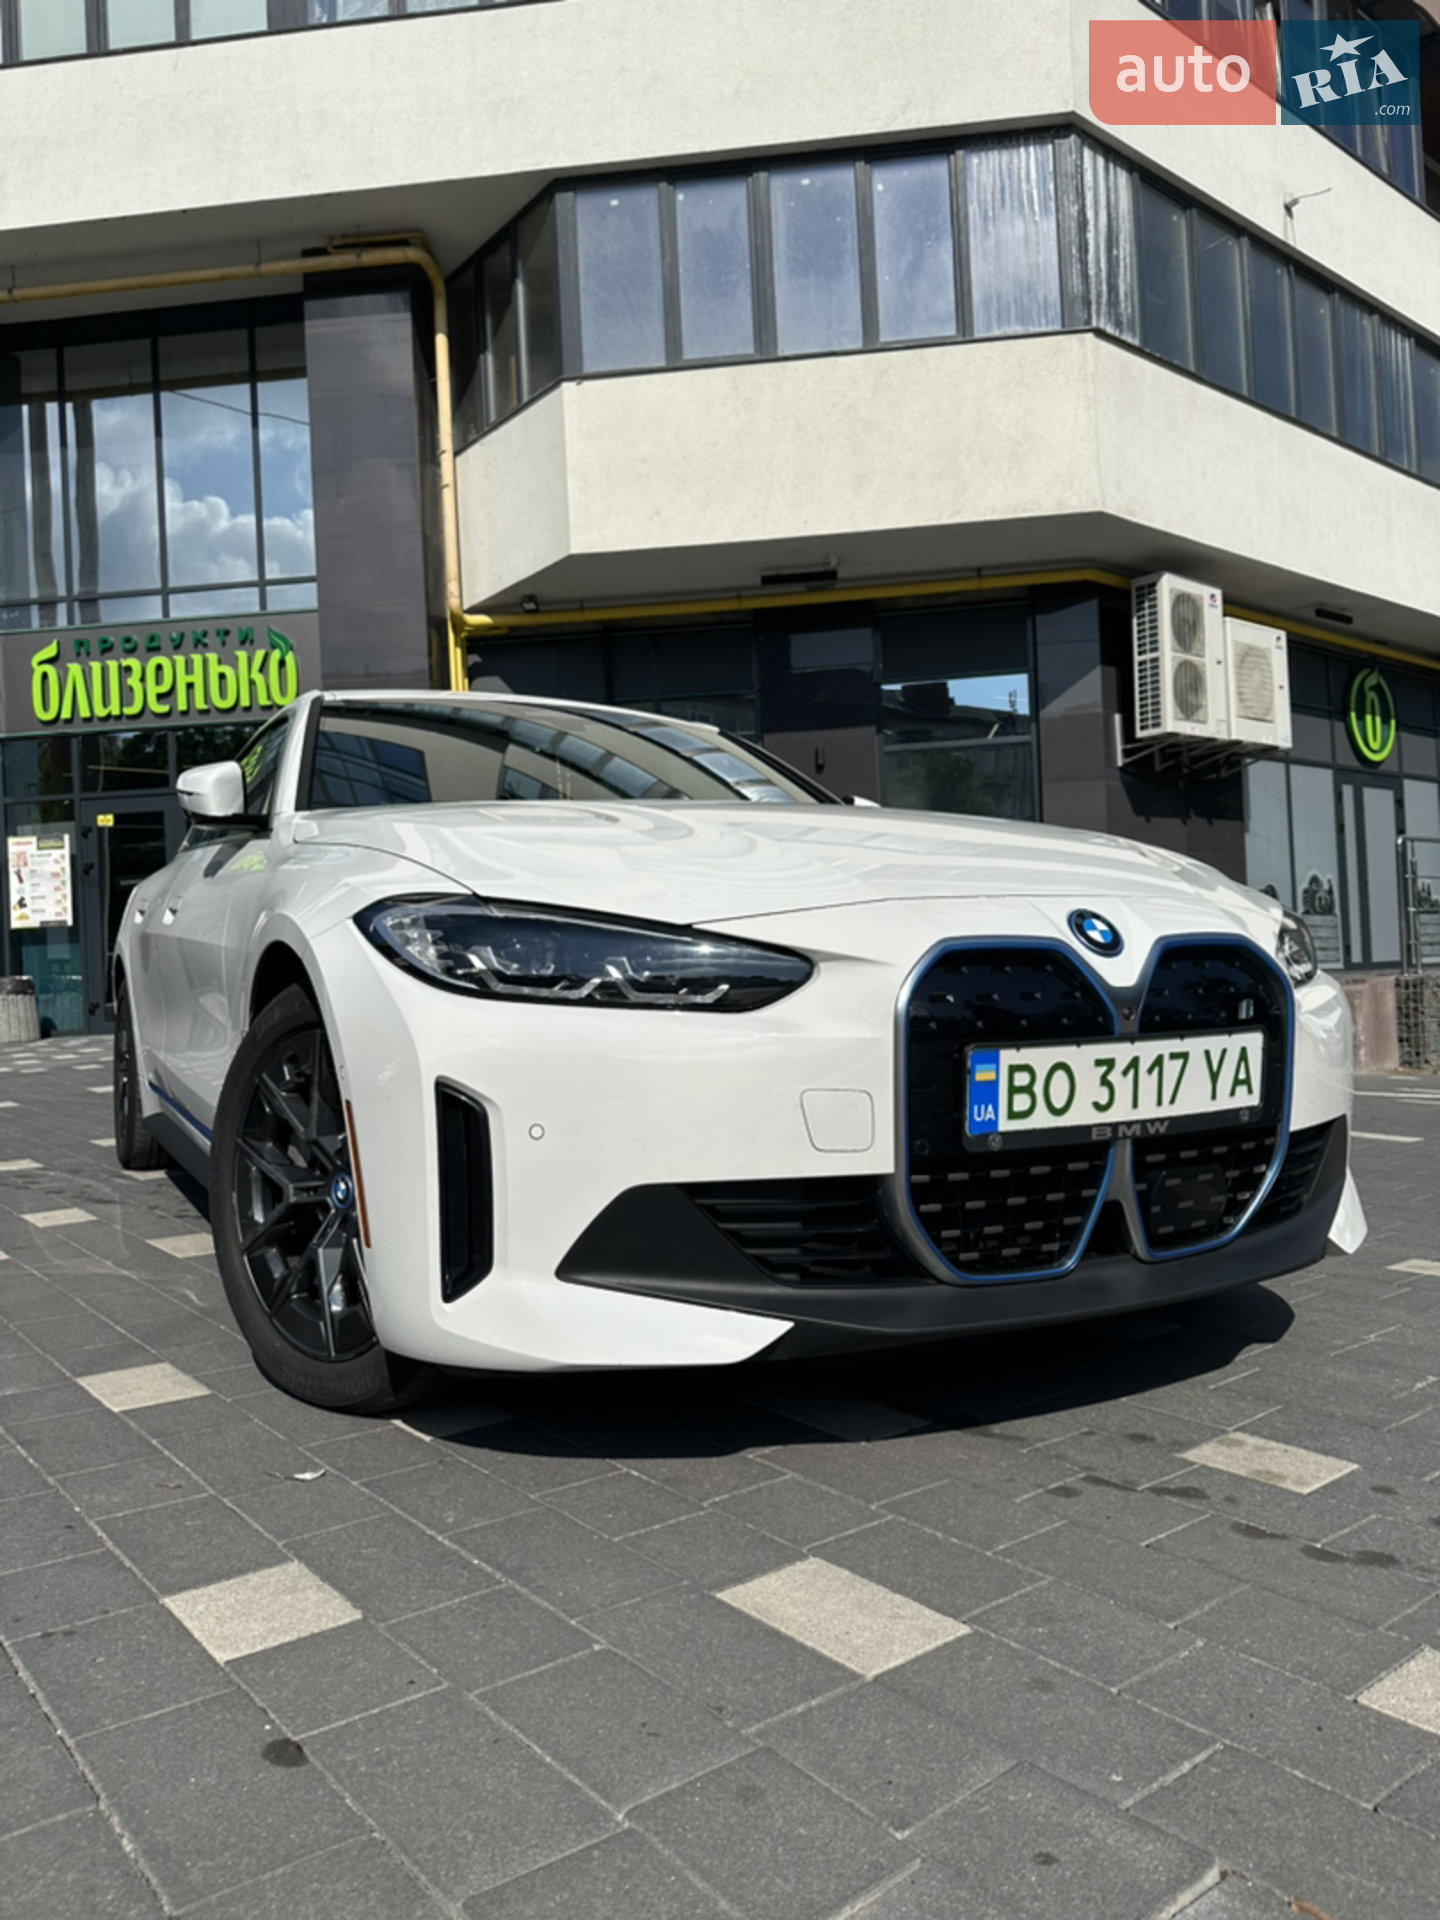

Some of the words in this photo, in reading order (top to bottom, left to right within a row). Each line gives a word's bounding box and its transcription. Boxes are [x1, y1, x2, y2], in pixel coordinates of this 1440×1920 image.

[73, 625, 255, 658] ПРОДУКТИ
[31, 638, 298, 722] близенько
[1006, 1060, 1077, 1121] BO
[1091, 1050, 1190, 1113] 3117
[1203, 1046, 1254, 1101] YA
[973, 1104, 996, 1122] UA
[1091, 1120, 1170, 1140] BMW
